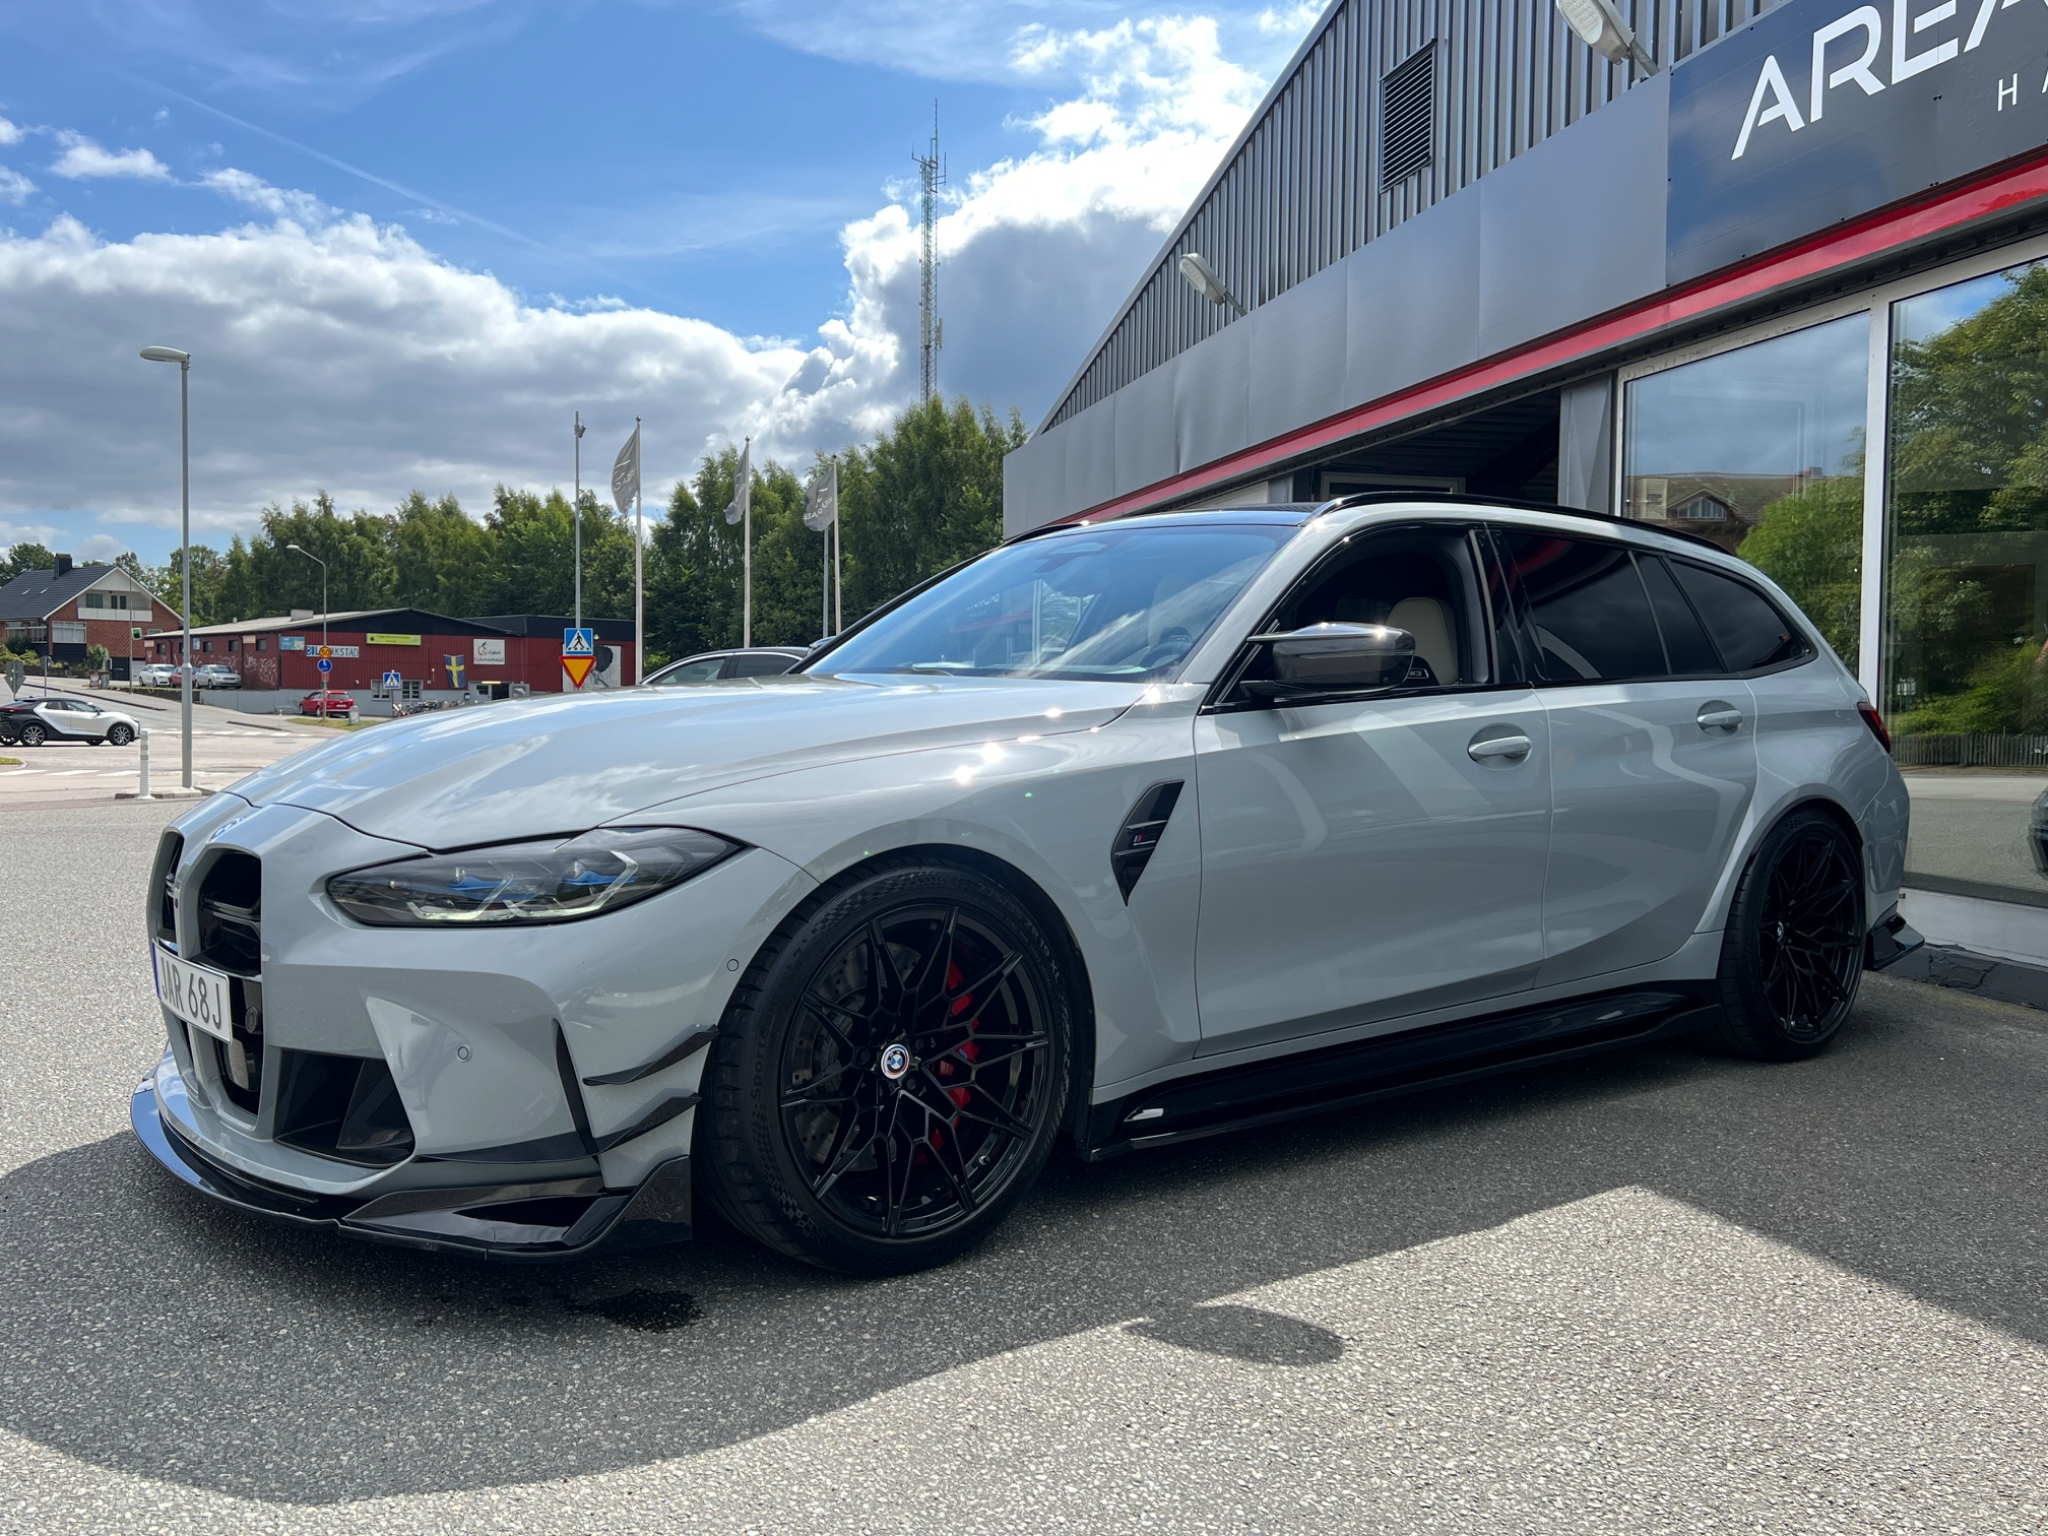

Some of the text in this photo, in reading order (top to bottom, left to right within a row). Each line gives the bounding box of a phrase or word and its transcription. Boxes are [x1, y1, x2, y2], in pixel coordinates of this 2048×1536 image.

[1998, 73, 2048, 111] H
[306, 646, 359, 657] BILRKSTAD
[161, 956, 222, 1030] JAR 68J
